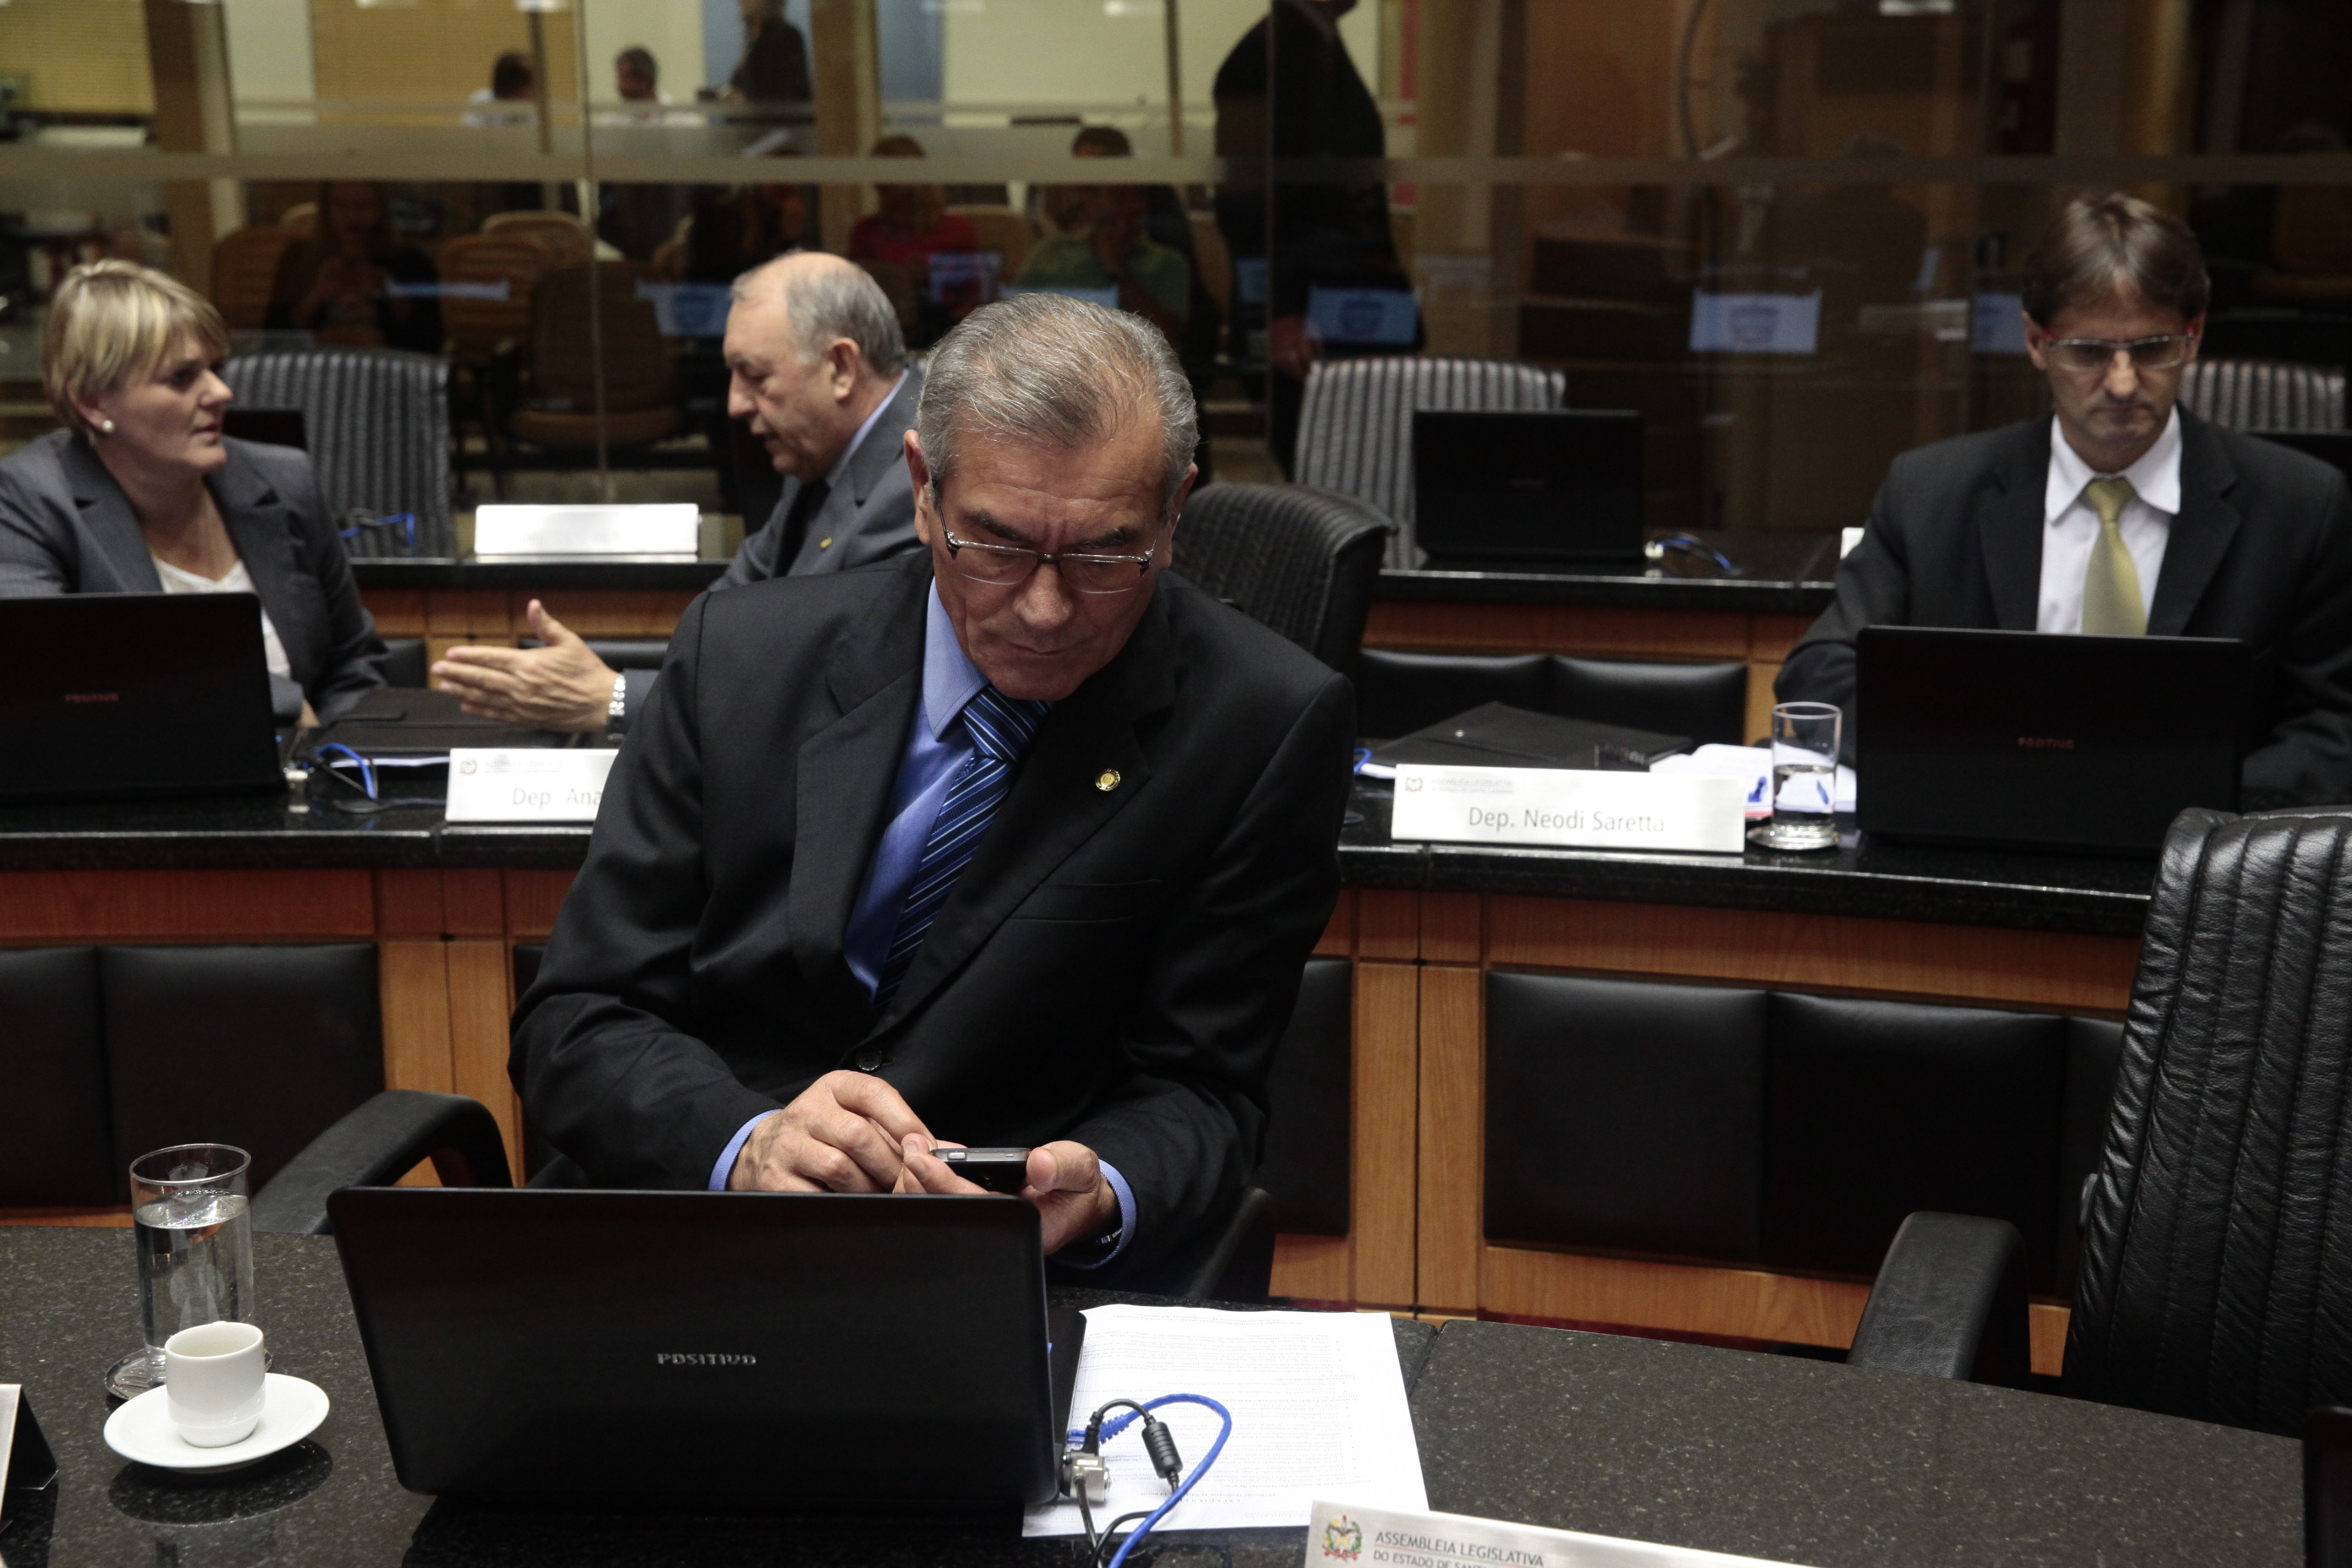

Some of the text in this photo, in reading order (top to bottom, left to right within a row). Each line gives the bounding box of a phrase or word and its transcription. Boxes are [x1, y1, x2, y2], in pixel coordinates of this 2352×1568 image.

[1468, 806, 1664, 832] Dep. Neodi Saretta
[656, 1353, 757, 1365] POSITIVO
[1374, 1549, 1389, 1561] DO
[1392, 1552, 1434, 1568] ESTADO
[1375, 1532, 1544, 1566] ASSEMBLEIA LEGISLATIVA
